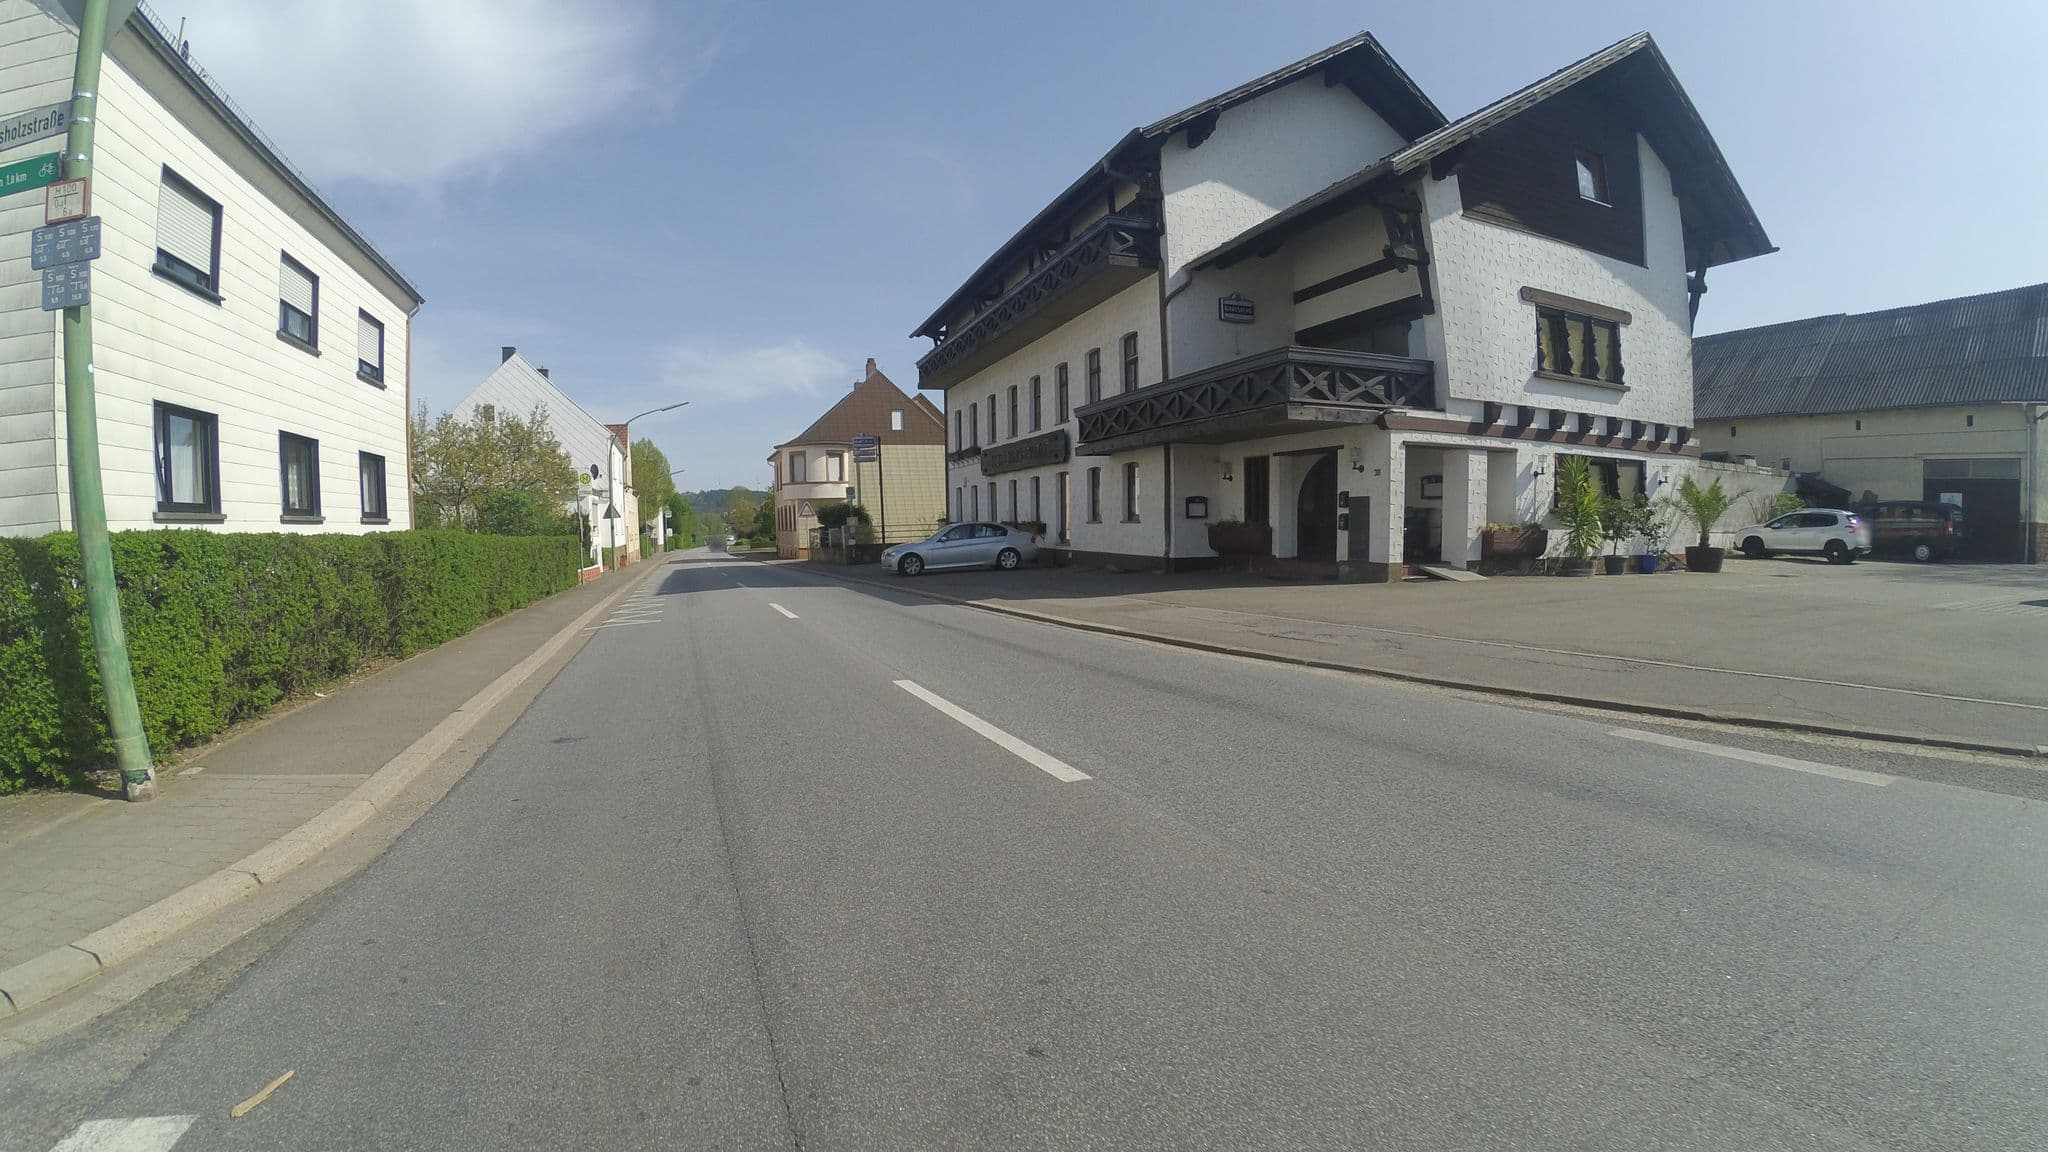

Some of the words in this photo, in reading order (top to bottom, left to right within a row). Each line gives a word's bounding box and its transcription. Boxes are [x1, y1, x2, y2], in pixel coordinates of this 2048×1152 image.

[36, 232, 43, 242] S
[58, 228, 65, 237] S
[47, 272, 54, 283] S
[70, 269, 77, 279] S
